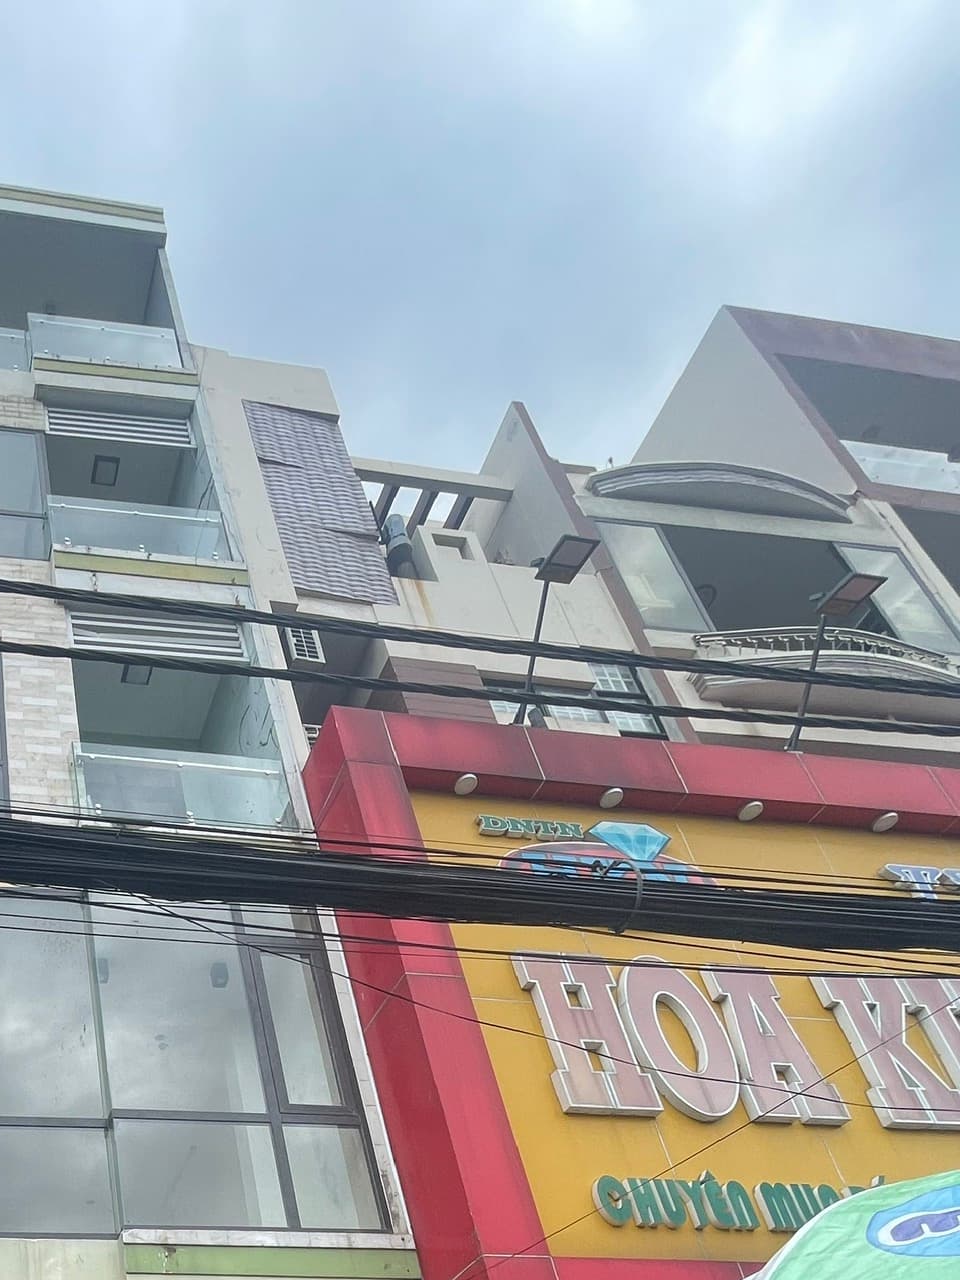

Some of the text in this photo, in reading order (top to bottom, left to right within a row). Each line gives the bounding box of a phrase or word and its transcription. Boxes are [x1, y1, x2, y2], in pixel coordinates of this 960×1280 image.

[477, 814, 585, 841] DNTN
[510, 951, 852, 1126] HOA
[591, 1169, 761, 1232] CHUYÊN
